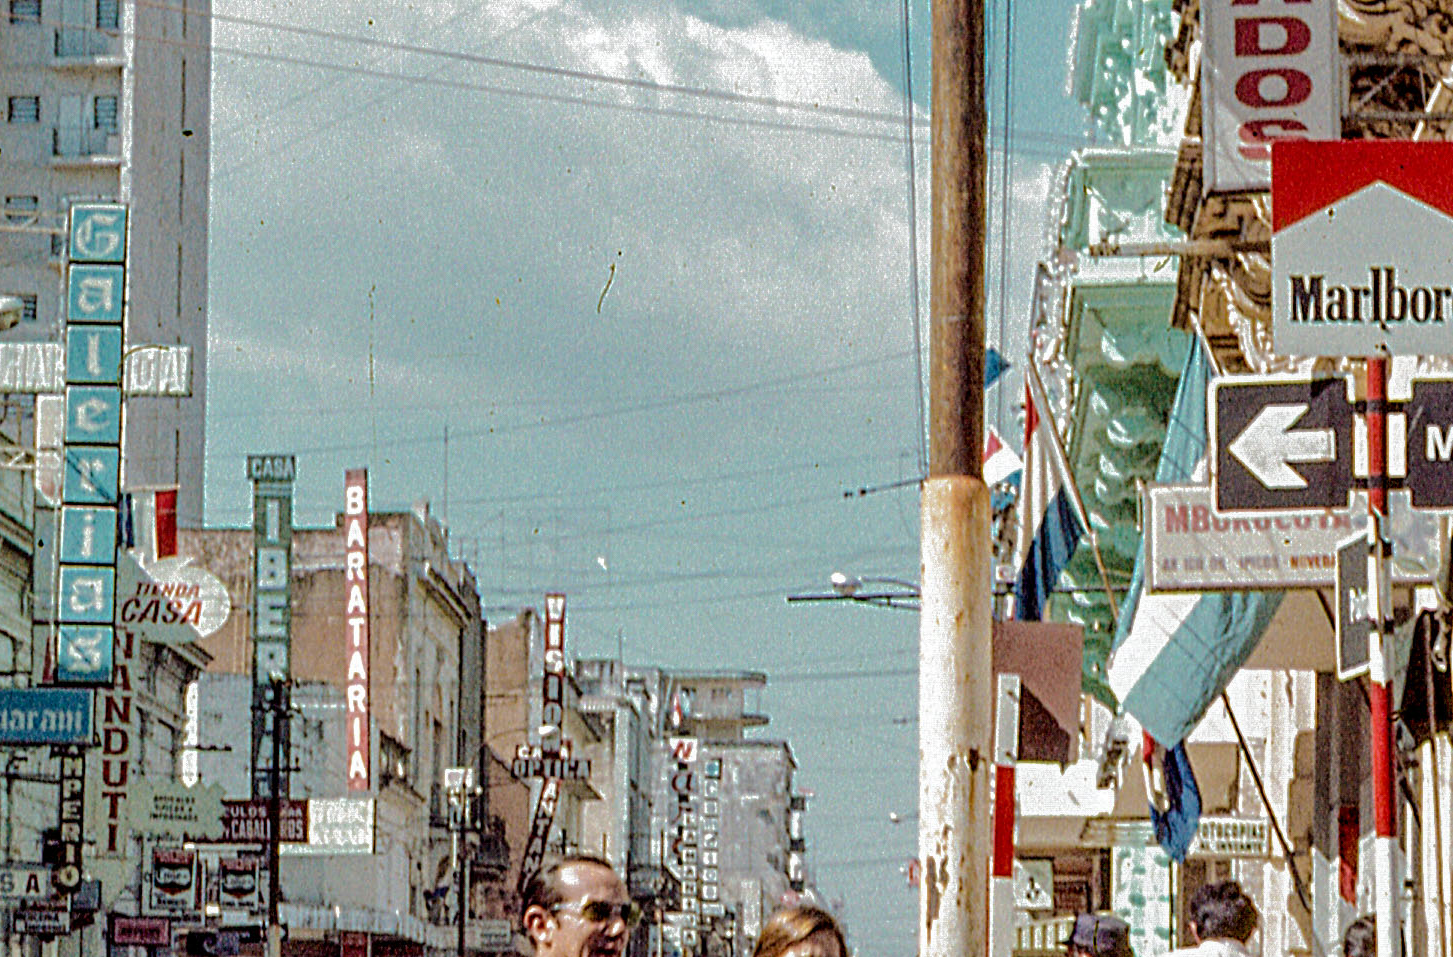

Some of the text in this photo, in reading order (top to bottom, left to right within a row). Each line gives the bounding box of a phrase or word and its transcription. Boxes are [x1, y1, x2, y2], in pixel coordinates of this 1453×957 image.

[1234, 0, 1313, 160] DOS
[67, 213, 120, 672] Galerias
[251, 458, 294, 480] CASA
[121, 598, 203, 627] CASA
[346, 486, 367, 779] BARATARIA
[518, 746, 569, 760] CAA
[1201, 821, 1265, 838] OTOCOPIAS
